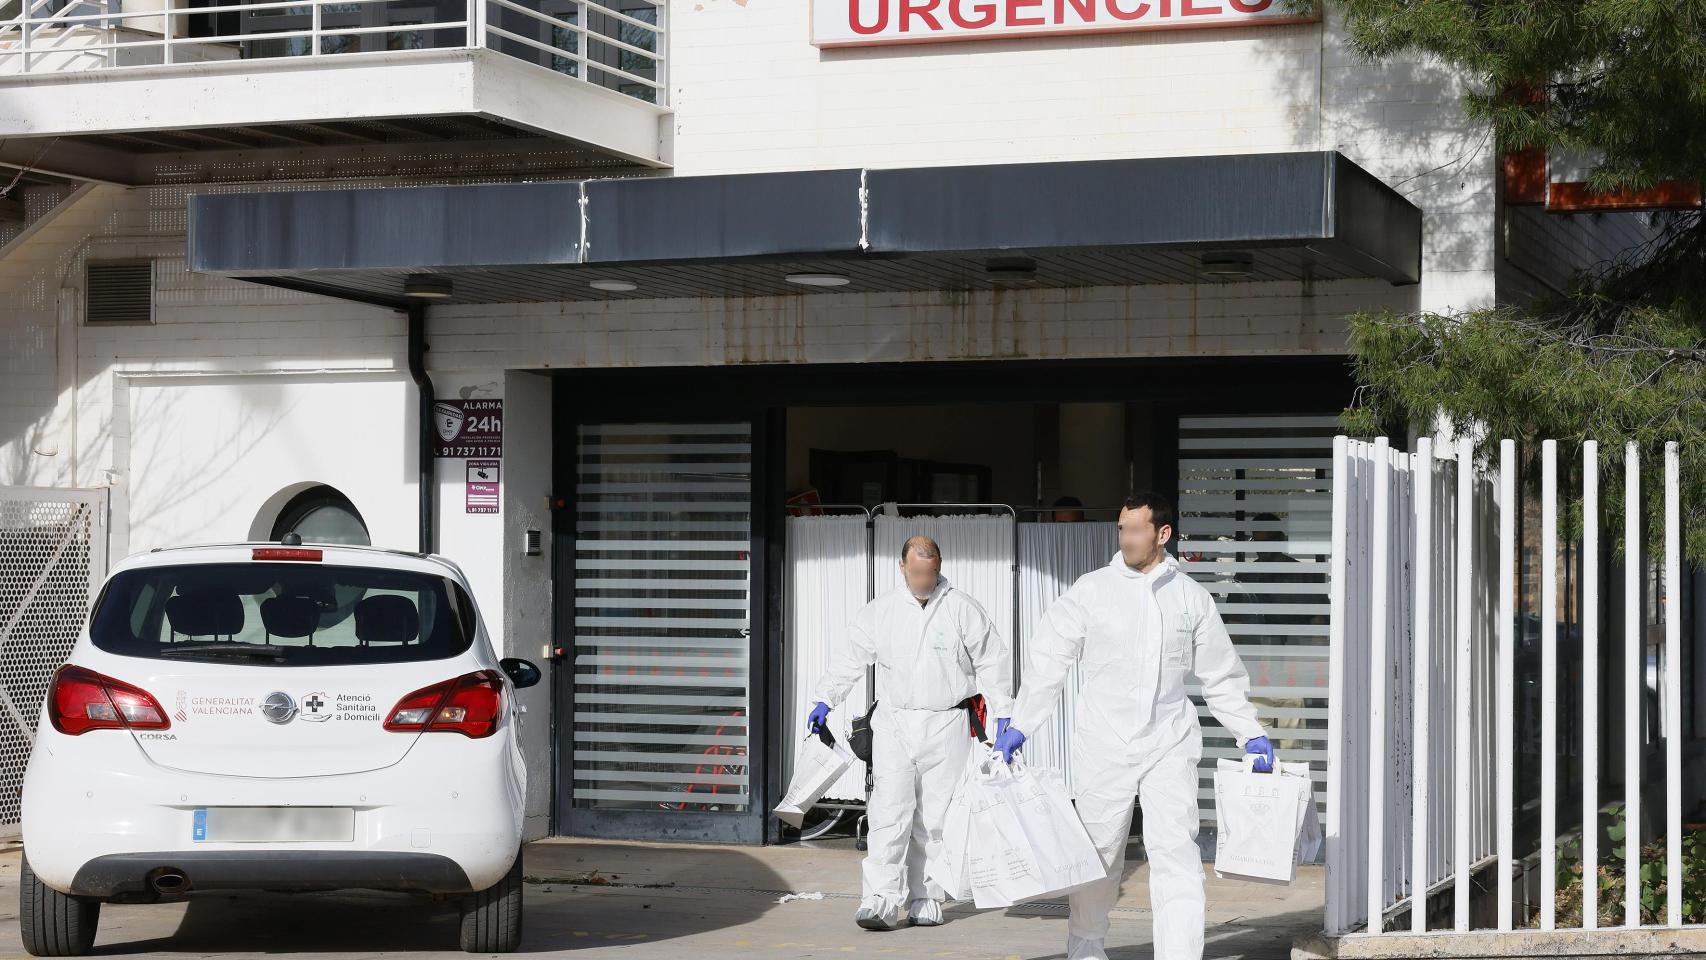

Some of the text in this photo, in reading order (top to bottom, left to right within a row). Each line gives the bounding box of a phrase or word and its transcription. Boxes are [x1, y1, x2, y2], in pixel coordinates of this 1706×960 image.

[849, 0, 1273, 34] URGEN
[463, 402, 502, 410] ALARMA
[467, 416, 501, 432] 24h
[443, 447, 501, 456] 91 737 11 71
[191, 697, 255, 706] GENERALITAT
[336, 694, 371, 702] Atenció
[192, 707, 253, 715] VALENCIANA
[344, 713, 380, 721] Domicili
[140, 733, 177, 741] CORSA
